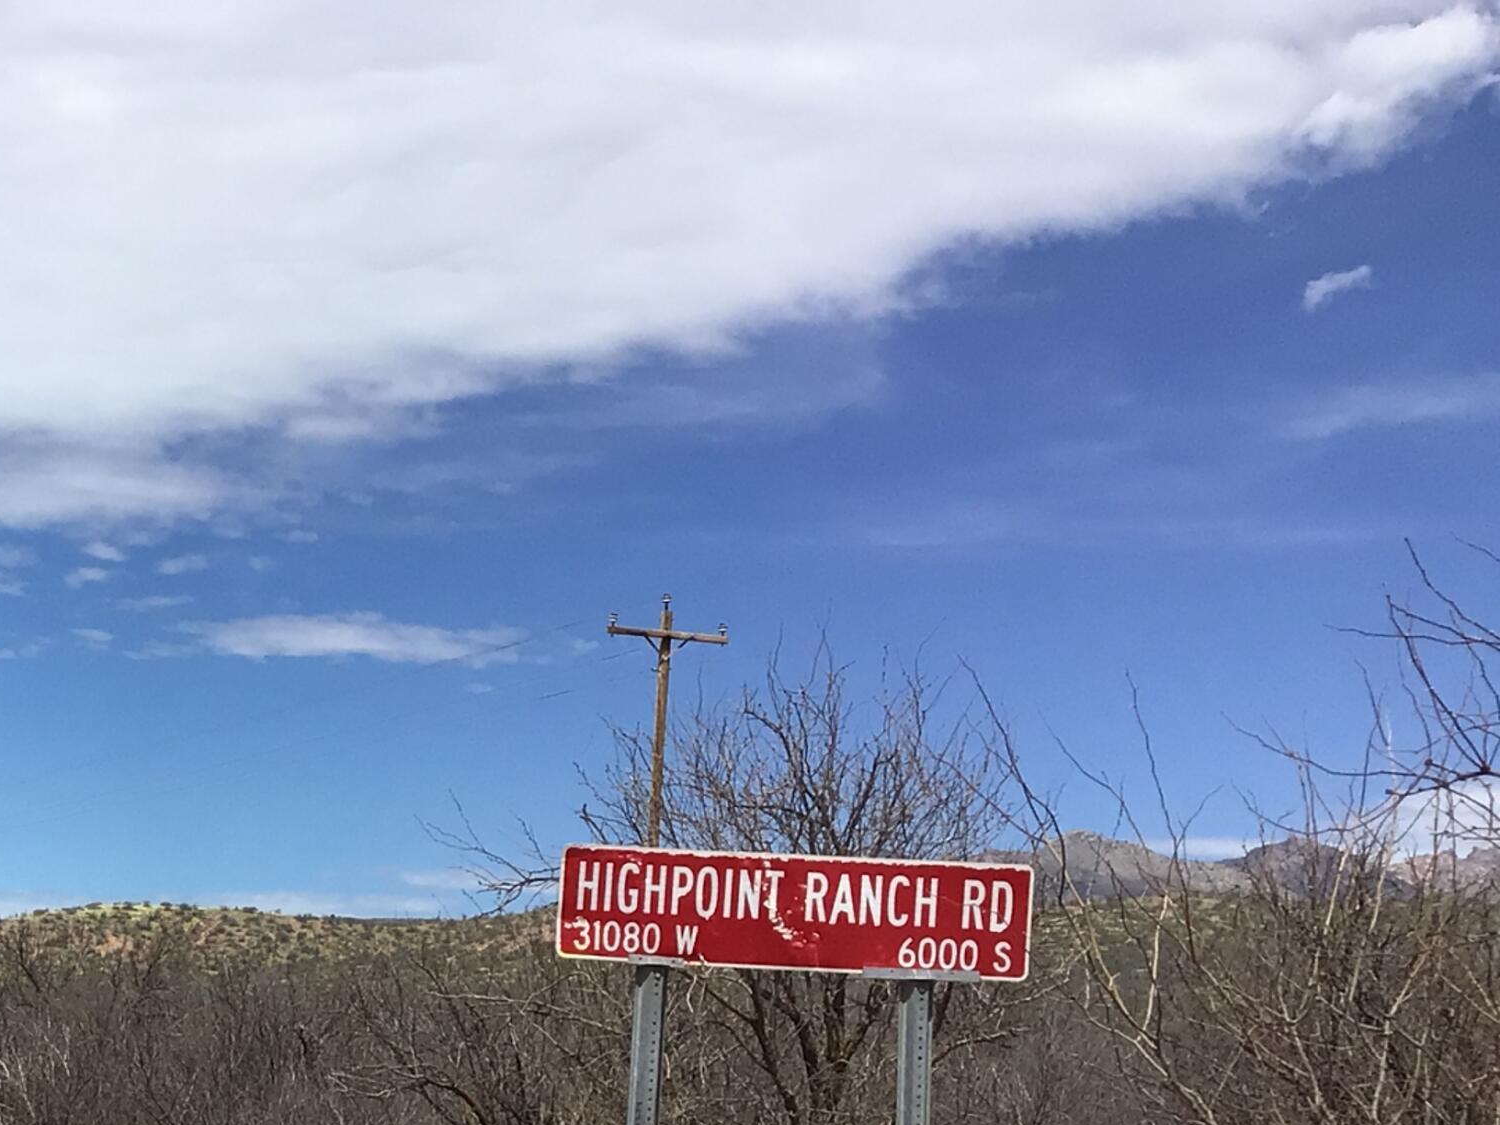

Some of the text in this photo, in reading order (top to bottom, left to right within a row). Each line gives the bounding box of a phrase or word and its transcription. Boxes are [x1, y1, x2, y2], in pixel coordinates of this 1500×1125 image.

[576, 860, 1014, 933] HIGHPOINT RANCH RD
[572, 918, 699, 955] 31080 W
[897, 936, 1013, 973] 6000 S
